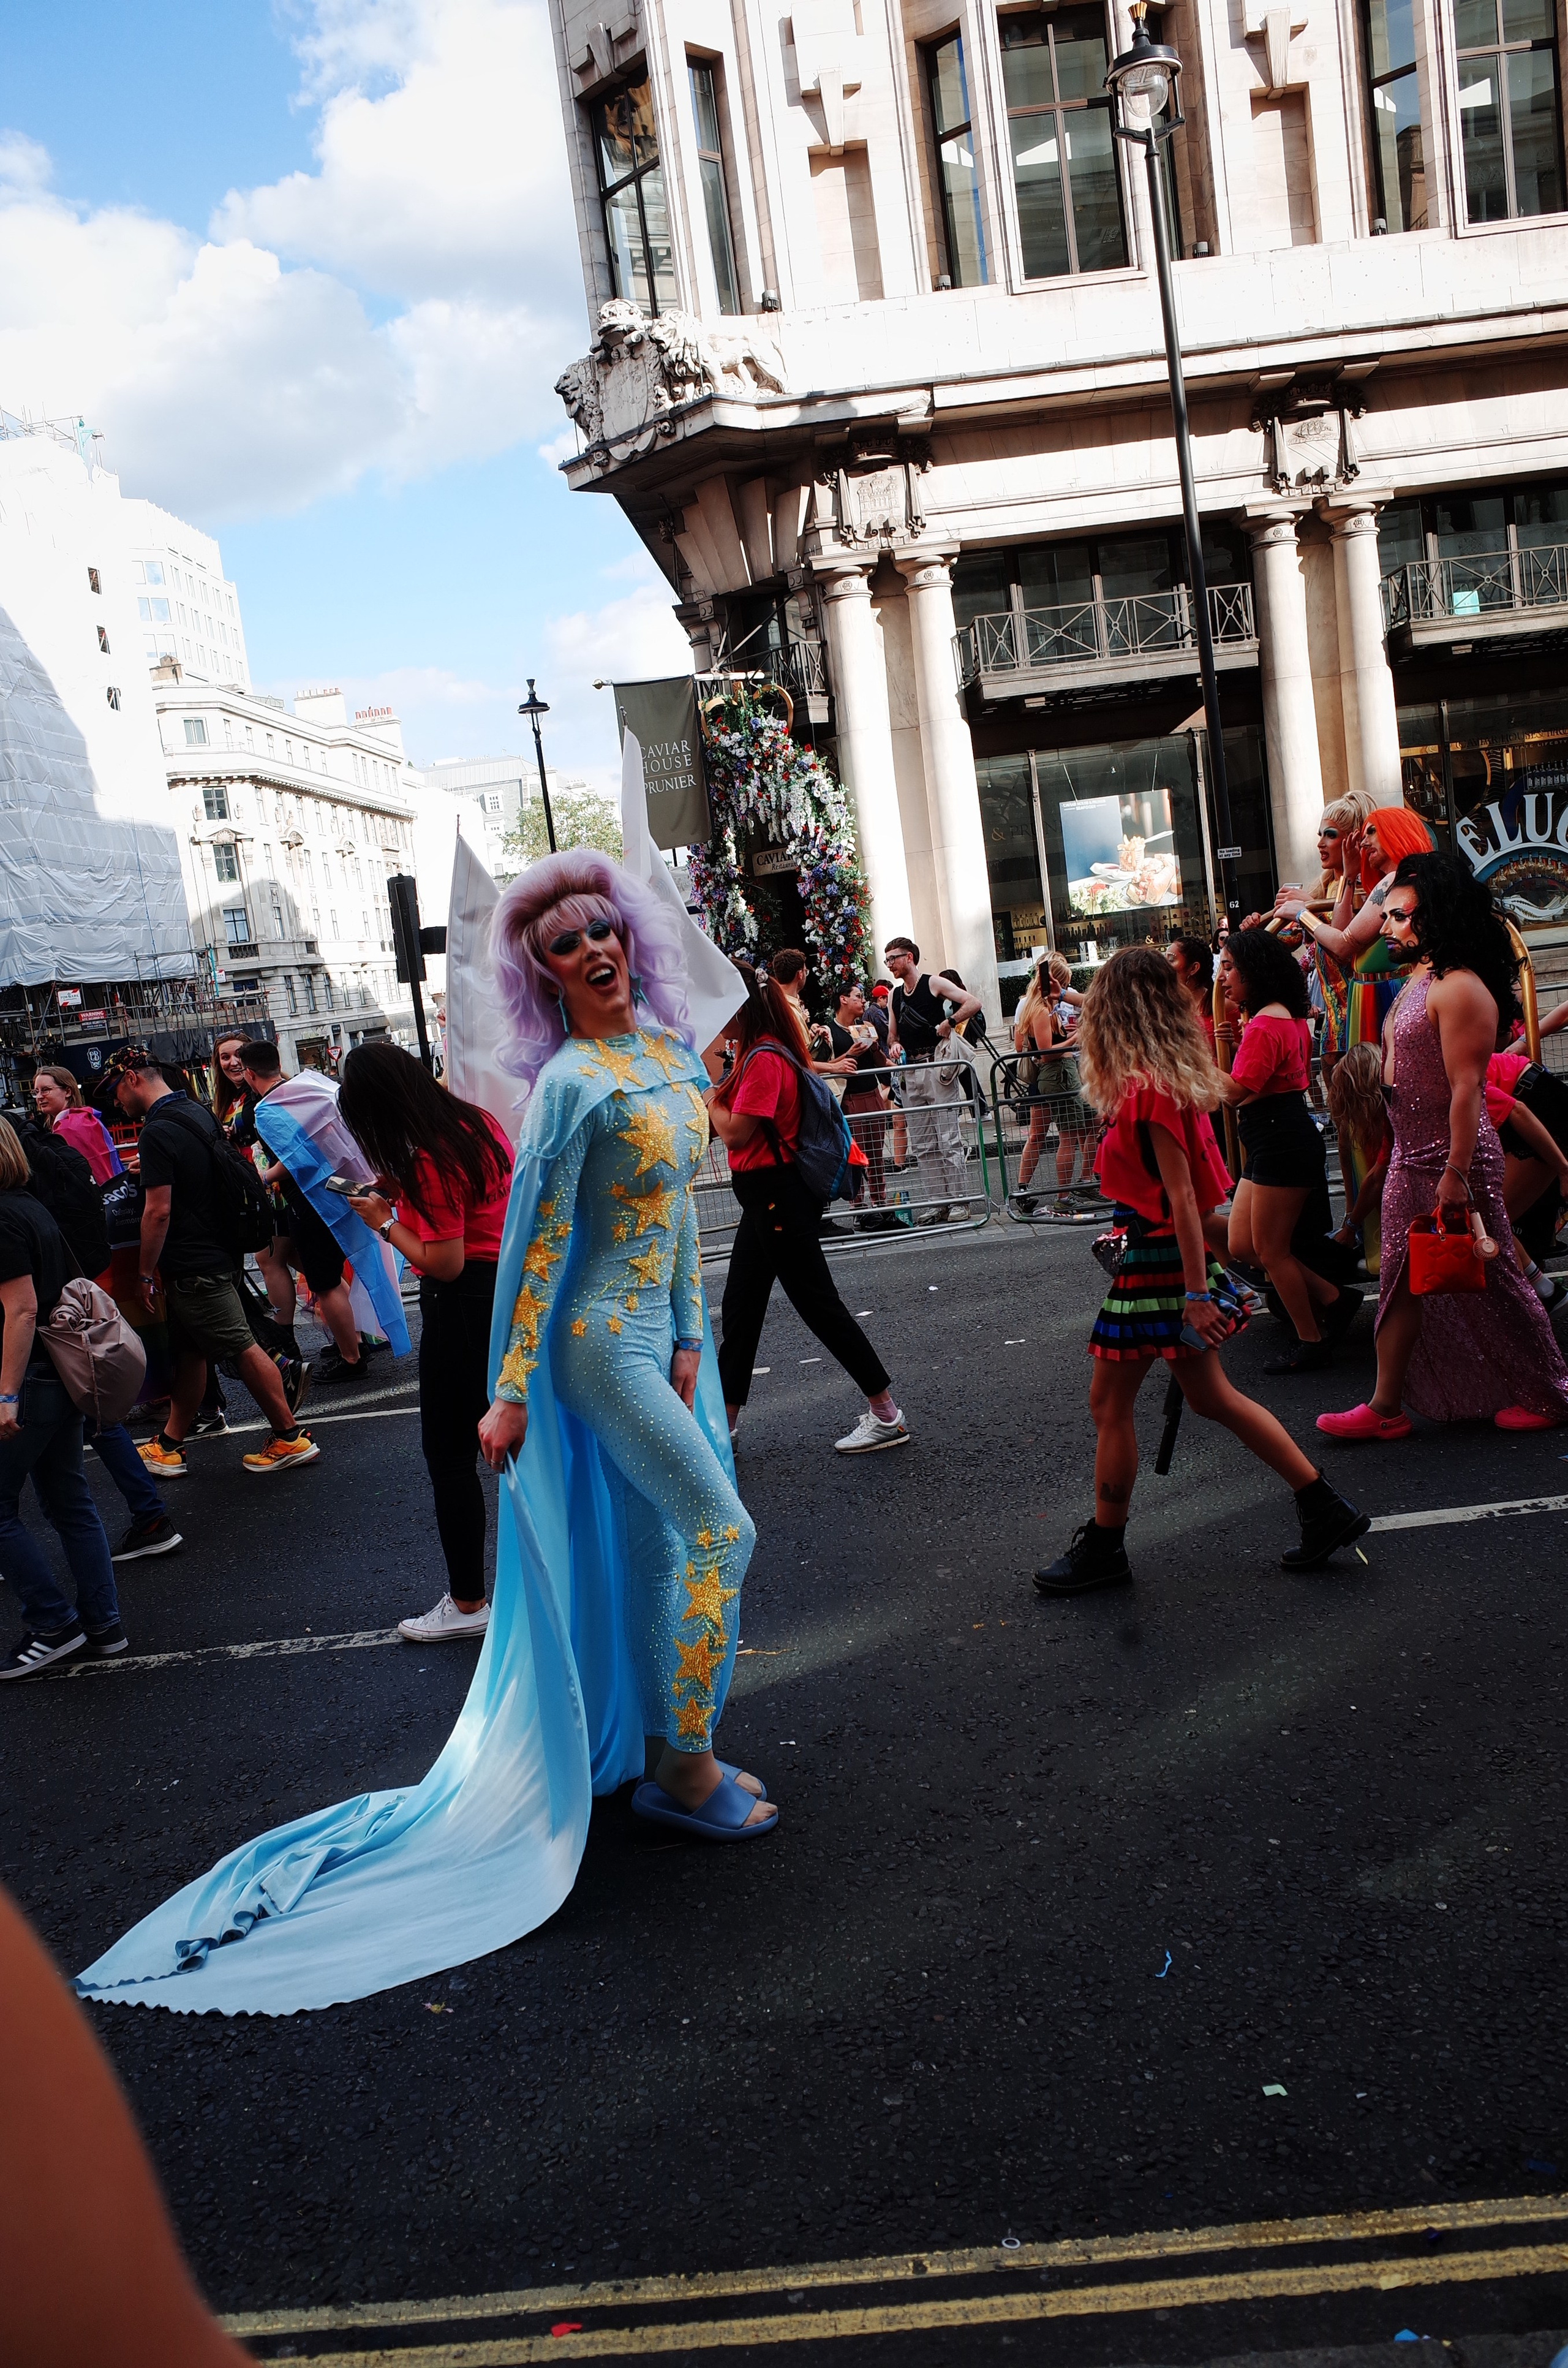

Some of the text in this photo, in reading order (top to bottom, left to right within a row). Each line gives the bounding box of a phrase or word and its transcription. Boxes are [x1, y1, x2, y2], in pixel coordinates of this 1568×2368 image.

[641, 740, 692, 759] CAVIAR
[643, 754, 692, 774] HOUSE
[644, 774, 697, 794] PRUNIER
[992, 827, 1006, 841] &
[772, 862, 797, 871] Restauran
